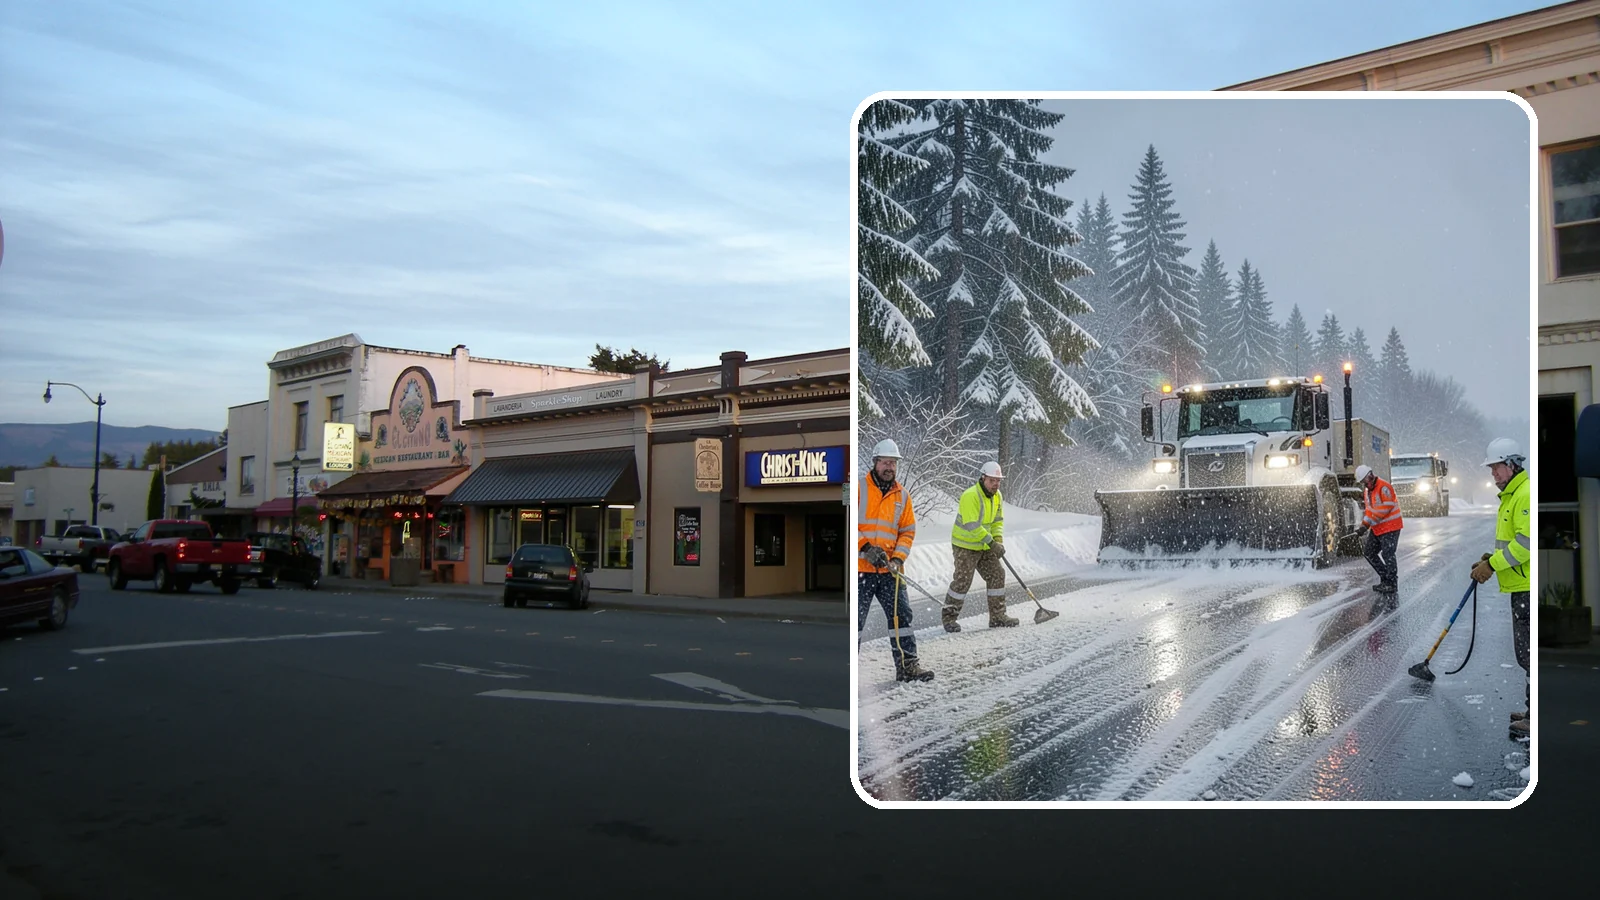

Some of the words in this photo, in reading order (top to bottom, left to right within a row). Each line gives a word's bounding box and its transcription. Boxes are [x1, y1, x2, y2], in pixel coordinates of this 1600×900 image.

[595, 389, 624, 400] LAUNDRY
[493, 402, 523, 412] LAVANDERIA
[373, 455, 396, 464] MEXICAN
[397, 451, 433, 462] RESTAURANT
[438, 450, 450, 459] BAR
[760, 452, 797, 478] CHRIST
[799, 450, 827, 476] KING
